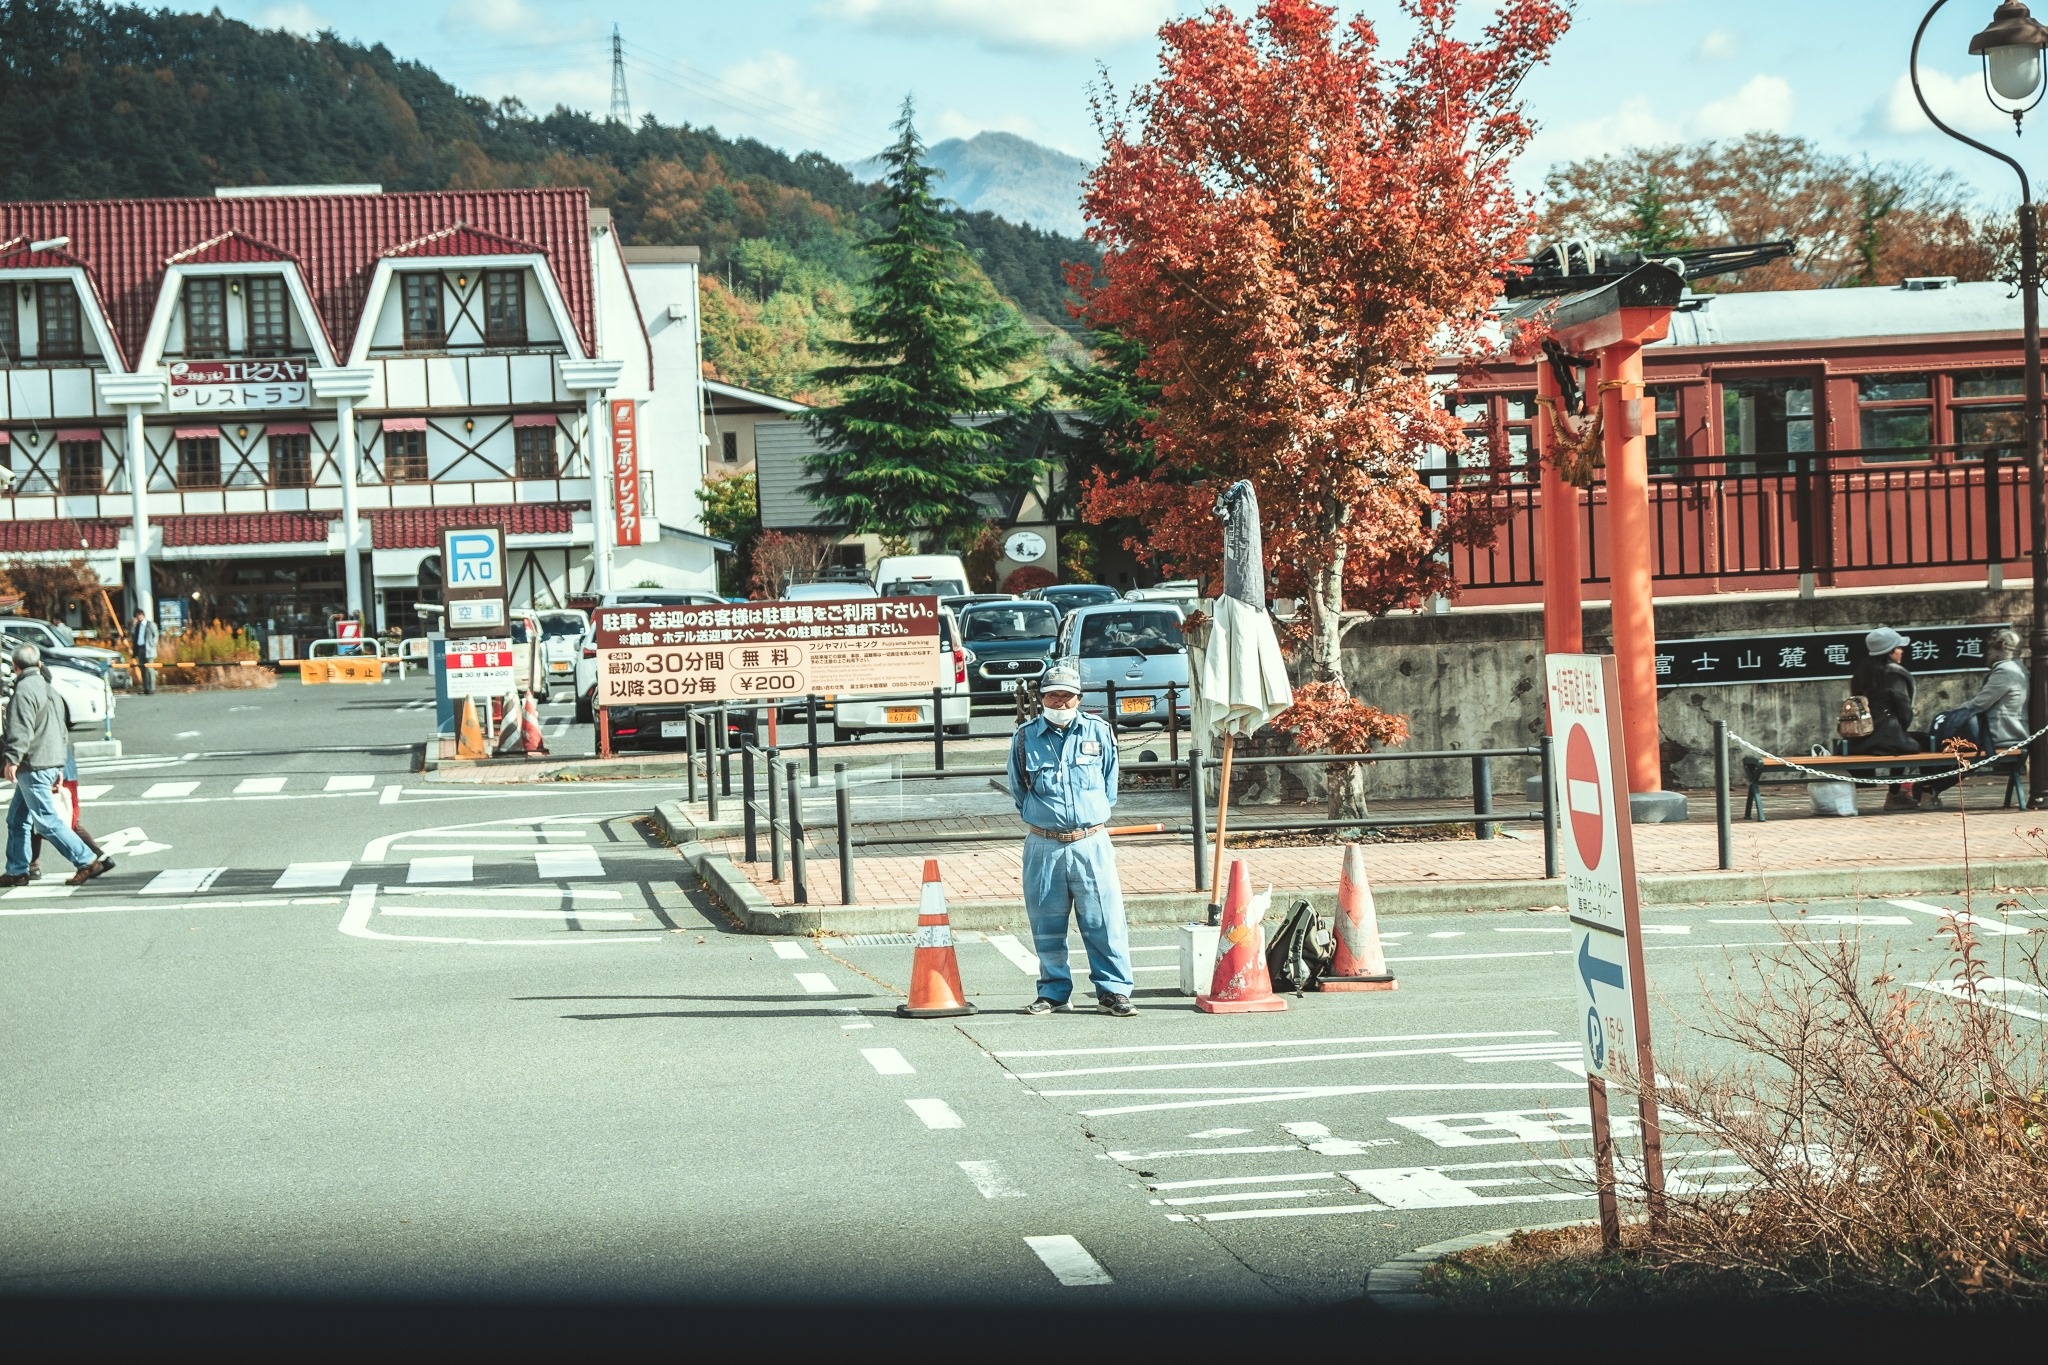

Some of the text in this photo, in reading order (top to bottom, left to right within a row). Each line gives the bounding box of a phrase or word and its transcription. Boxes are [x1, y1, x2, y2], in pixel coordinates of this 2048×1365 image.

[195, 387, 305, 405] レストラン
[616, 429, 637, 541] ニッポンレンタカー
[450, 535, 495, 582] P
[462, 561, 492, 580] 入口
[458, 605, 494, 620] 空車
[603, 602, 934, 631] 駐車・送迎のお客様は駐車場をご利用下さい。
[1655, 637, 1984, 675] 富士山麓電鉄道
[610, 677, 717, 697] 以降30分毎
[1604, 1016, 1624, 1046] 15分
